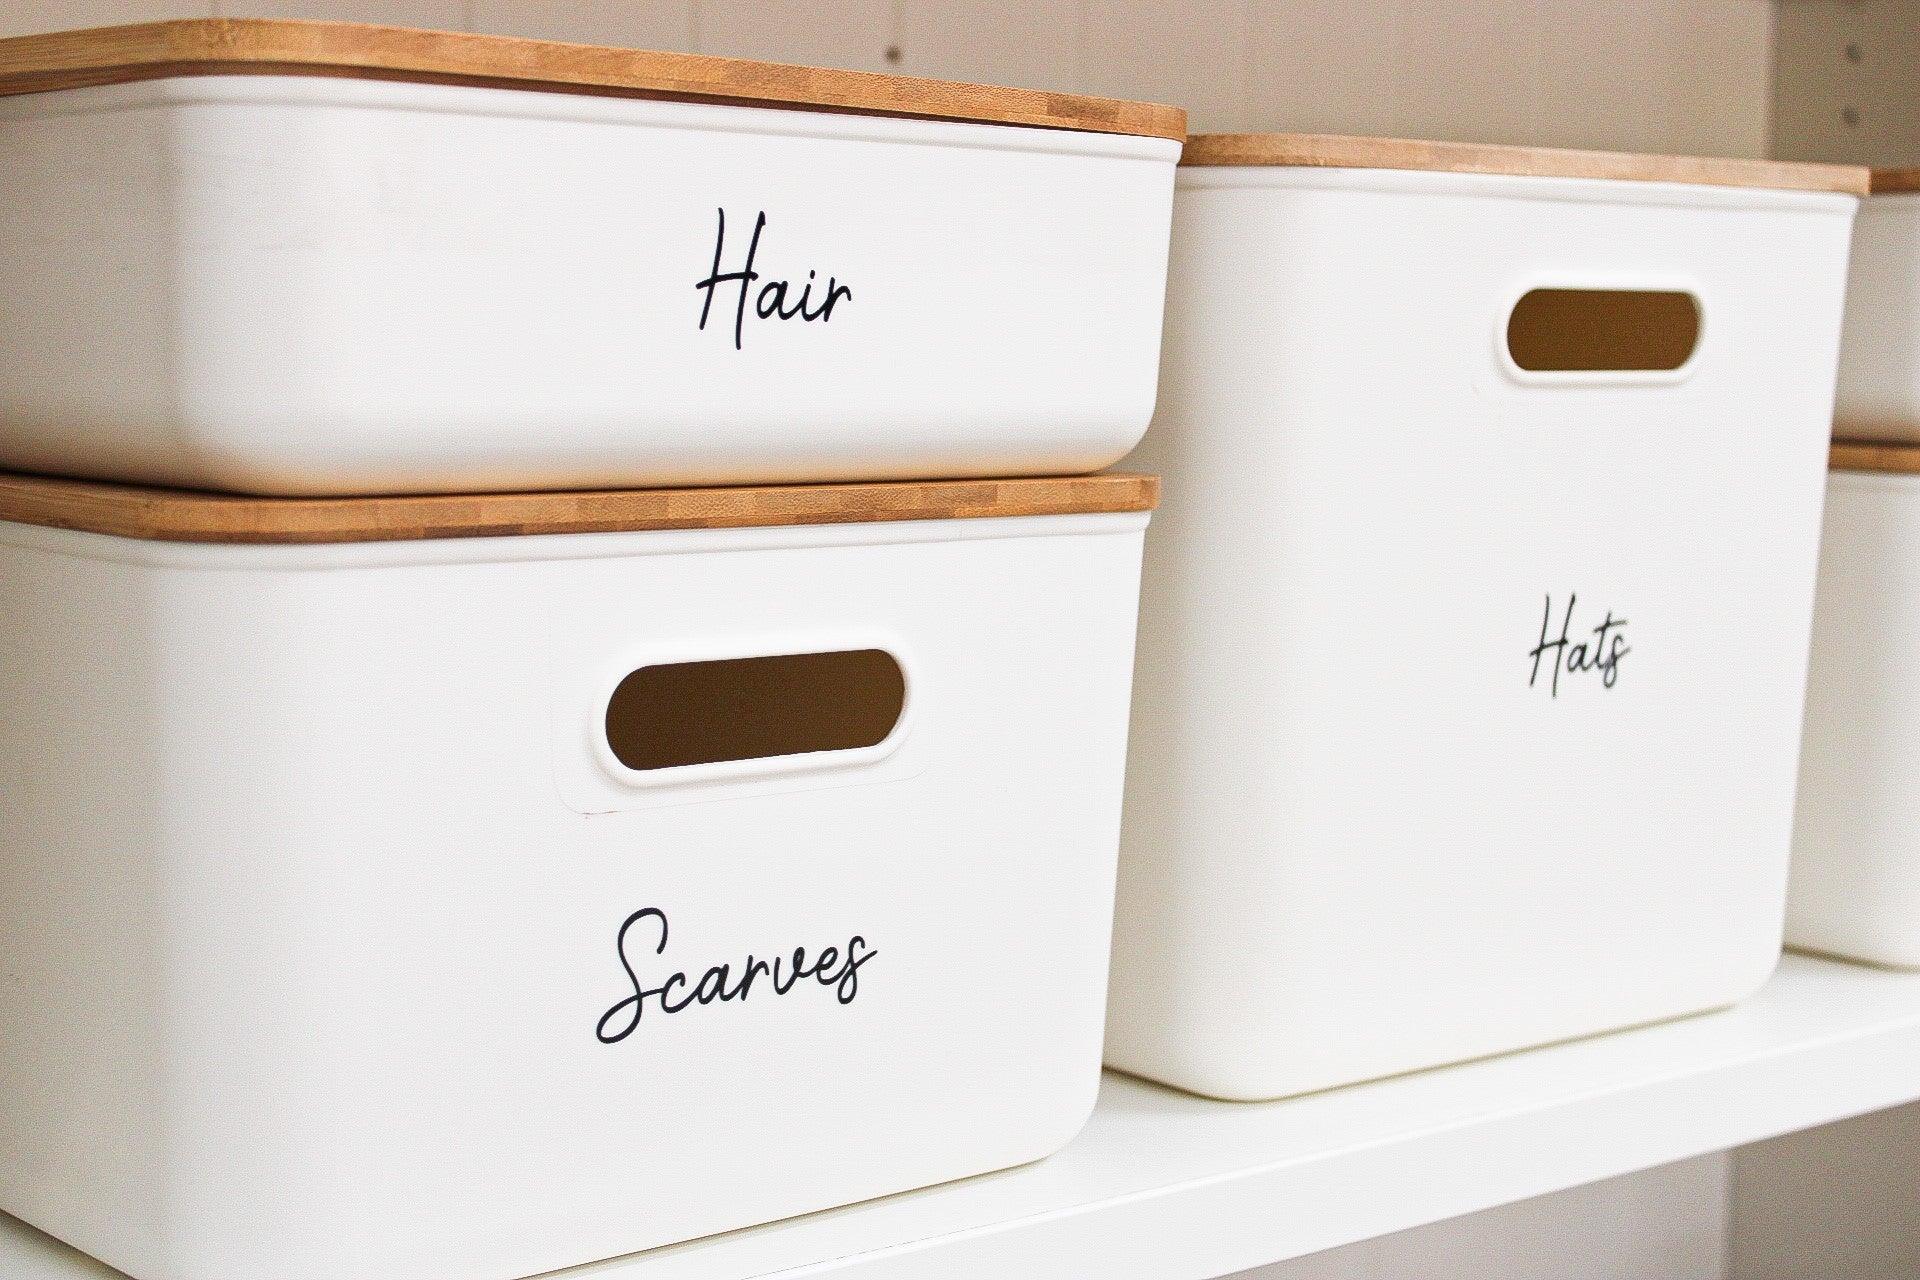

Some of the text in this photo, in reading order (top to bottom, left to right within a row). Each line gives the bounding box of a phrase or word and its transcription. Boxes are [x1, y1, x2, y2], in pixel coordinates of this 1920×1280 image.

[695, 207, 852, 350] Hair
[1529, 593, 1631, 699] Hats
[596, 907, 878, 1044] Scarves
